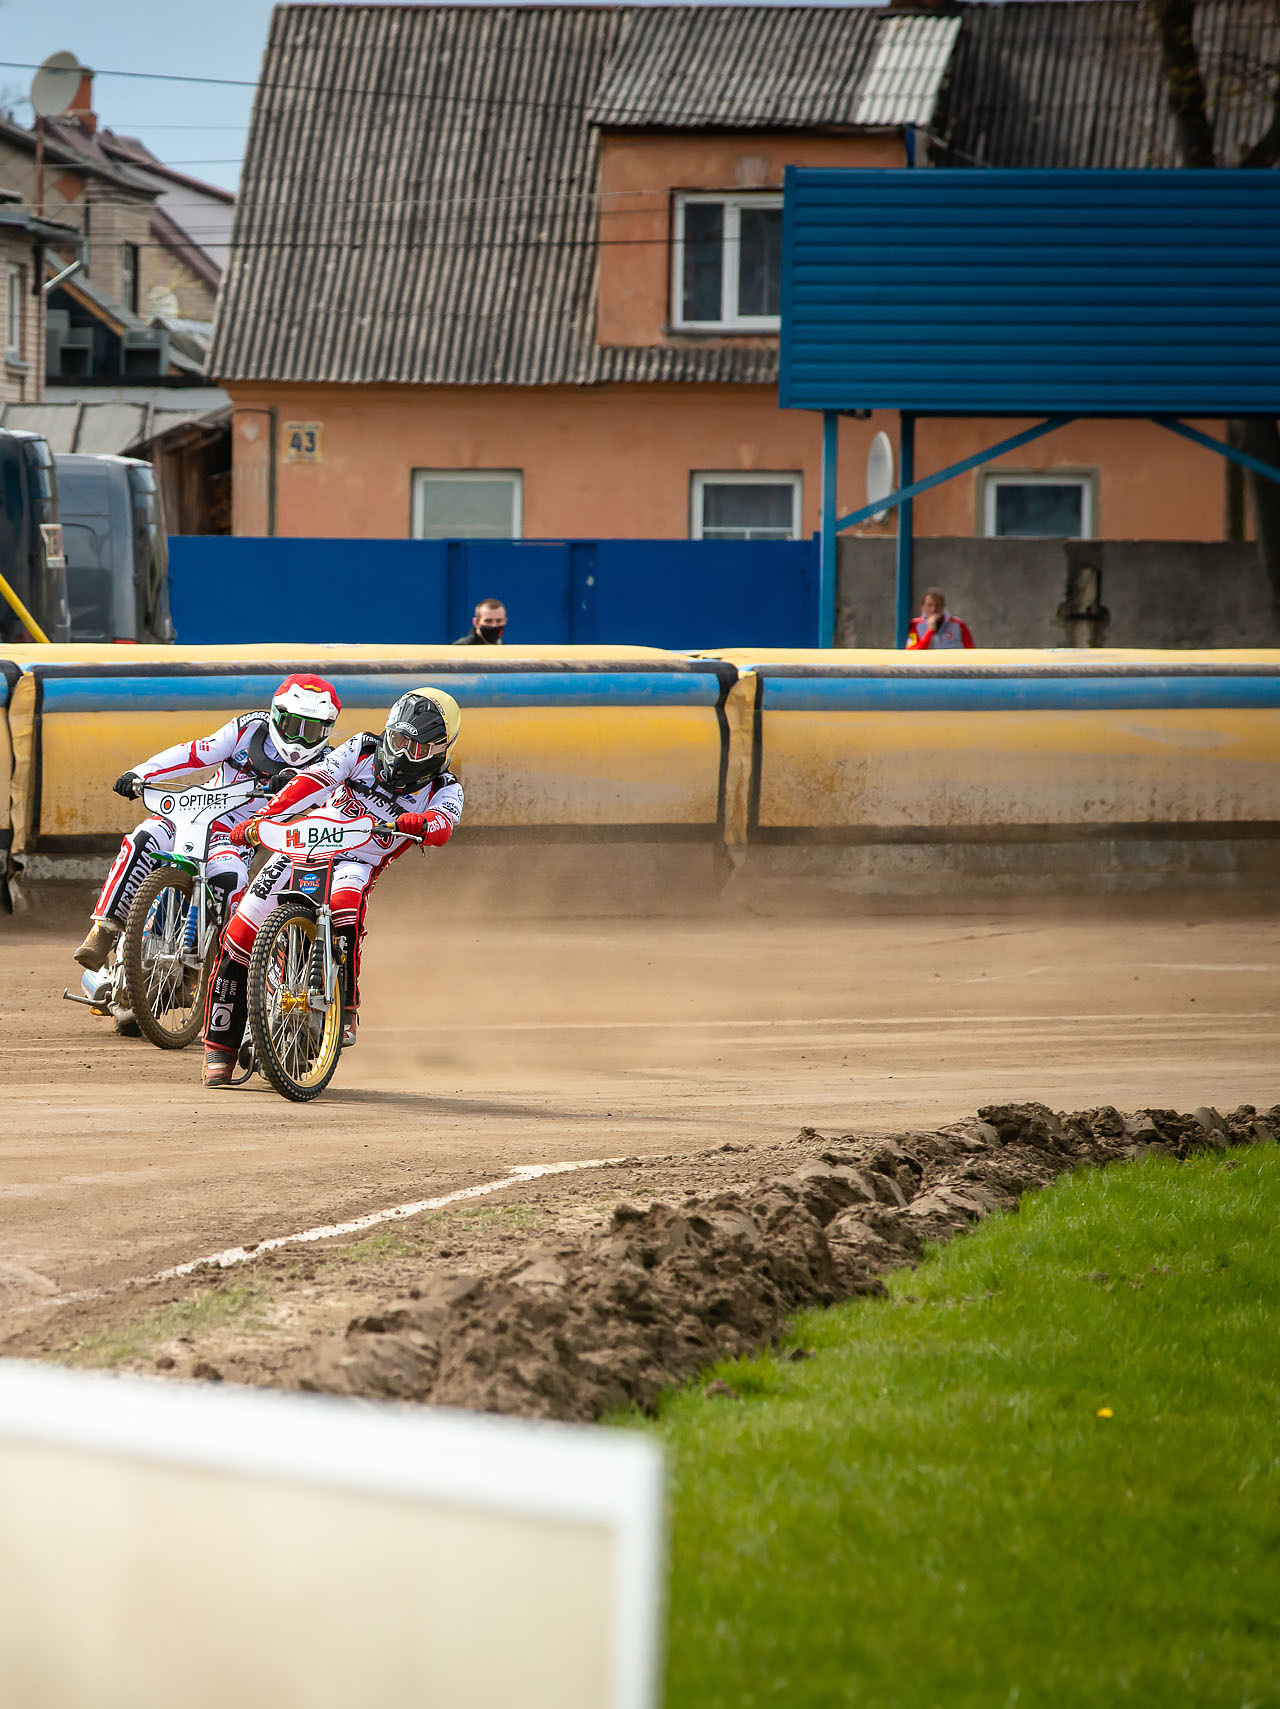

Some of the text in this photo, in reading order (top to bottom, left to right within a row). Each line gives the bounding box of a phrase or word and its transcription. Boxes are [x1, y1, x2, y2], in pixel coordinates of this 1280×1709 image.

[289, 431, 316, 453] 43
[178, 793, 230, 808] OPTIBET
[285, 827, 344, 849] HL BAU
[258, 854, 295, 901] RACIN
[214, 976, 223, 994] Sport
